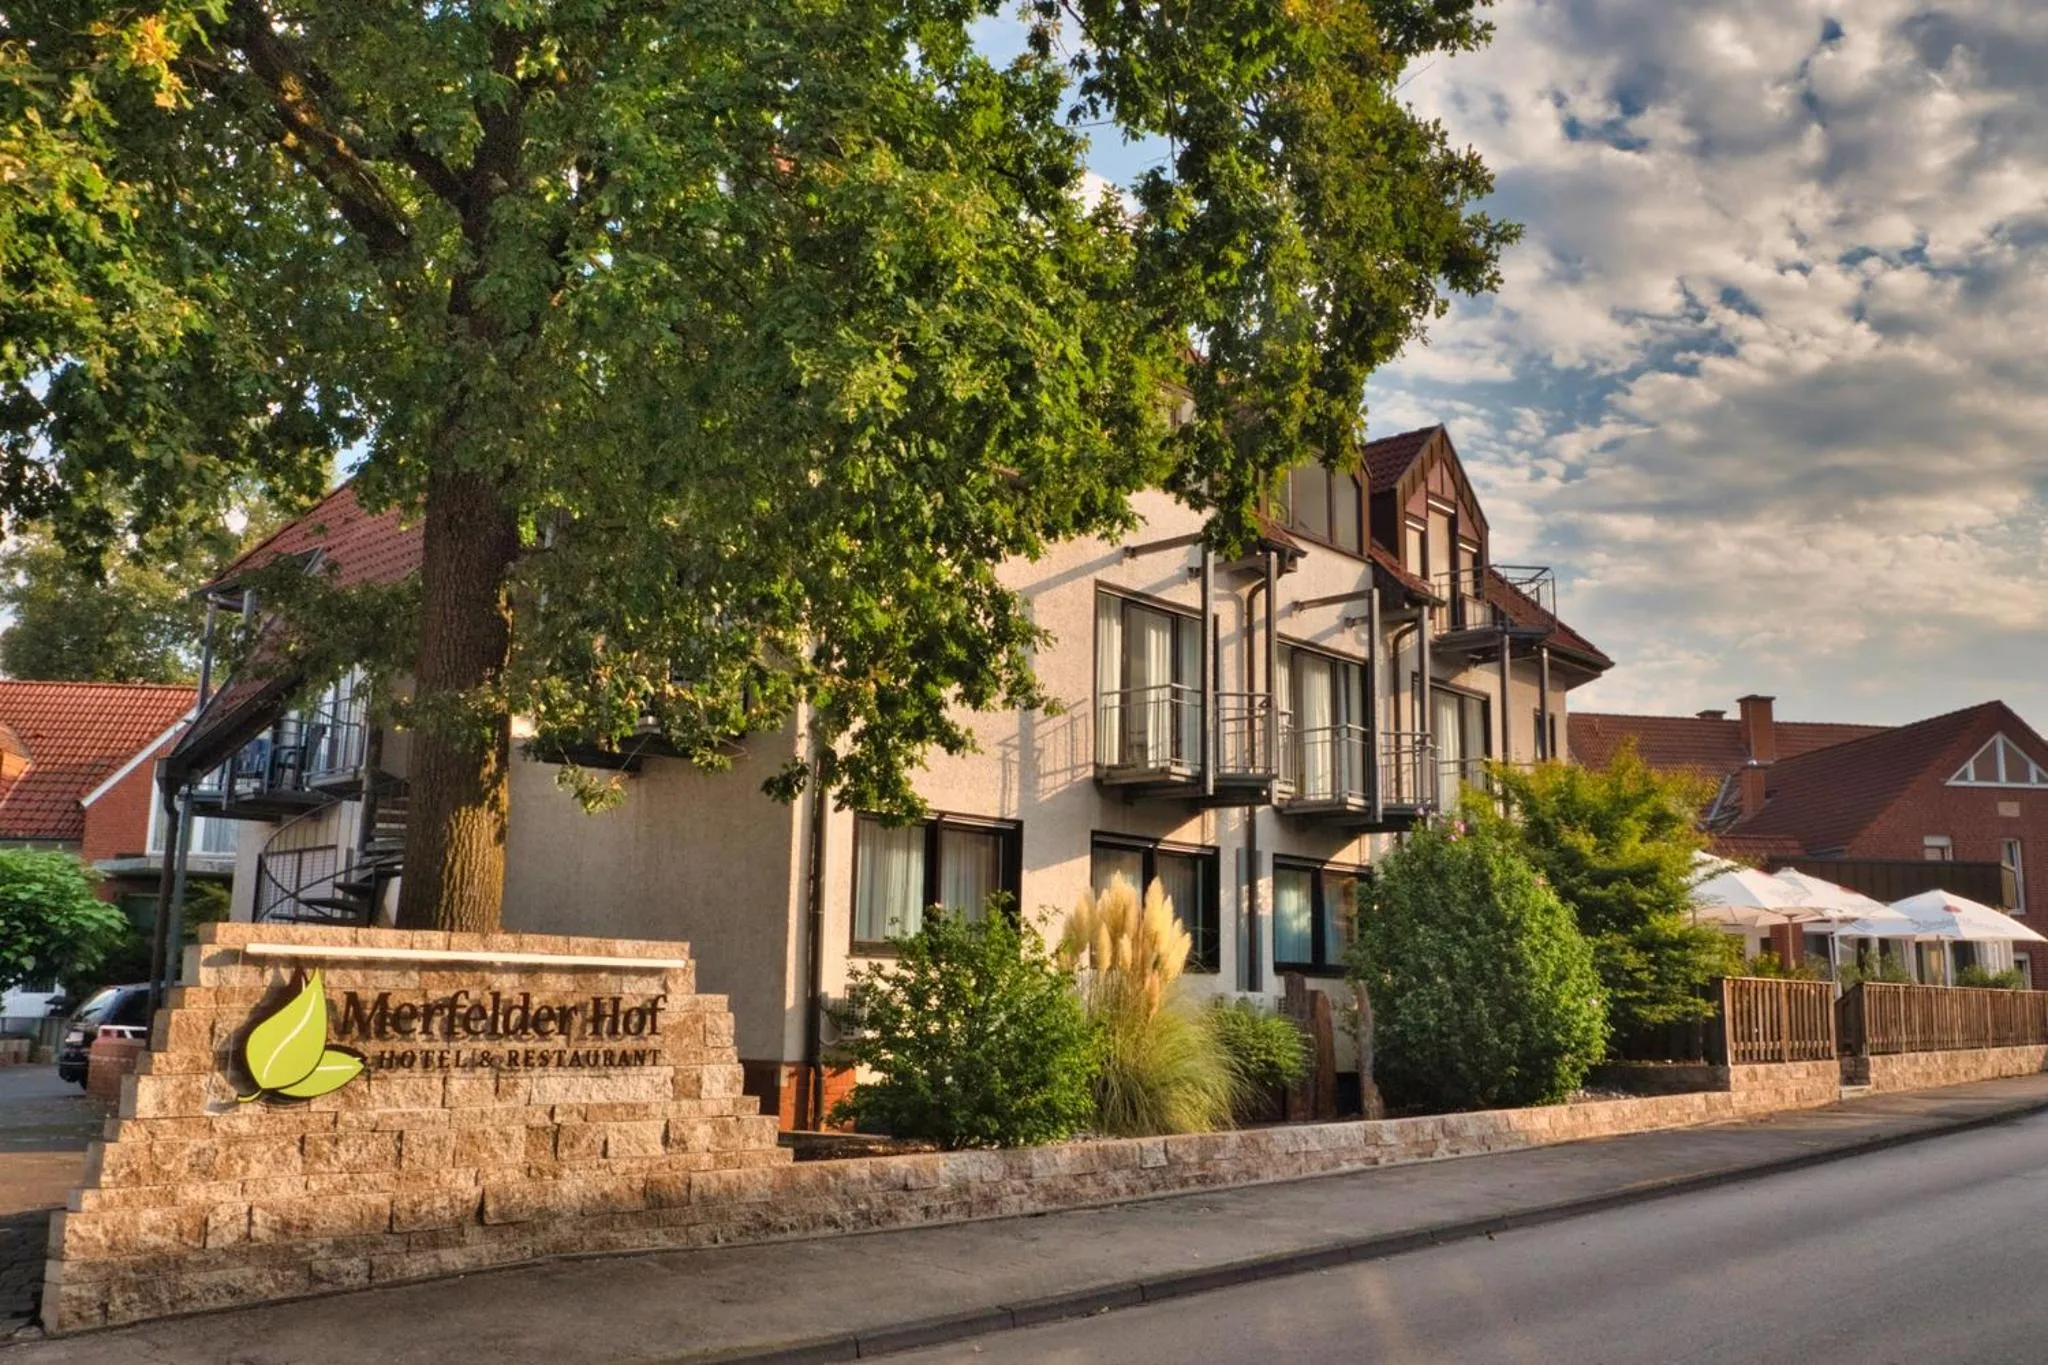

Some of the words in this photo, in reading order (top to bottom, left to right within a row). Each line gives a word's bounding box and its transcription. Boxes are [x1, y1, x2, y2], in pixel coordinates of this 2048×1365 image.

[337, 989, 578, 1037] Merfelder
[588, 994, 668, 1037] Hof
[378, 1049, 467, 1069] HOTEL
[479, 1049, 494, 1068] &
[507, 1049, 662, 1068] RESTAURANT
